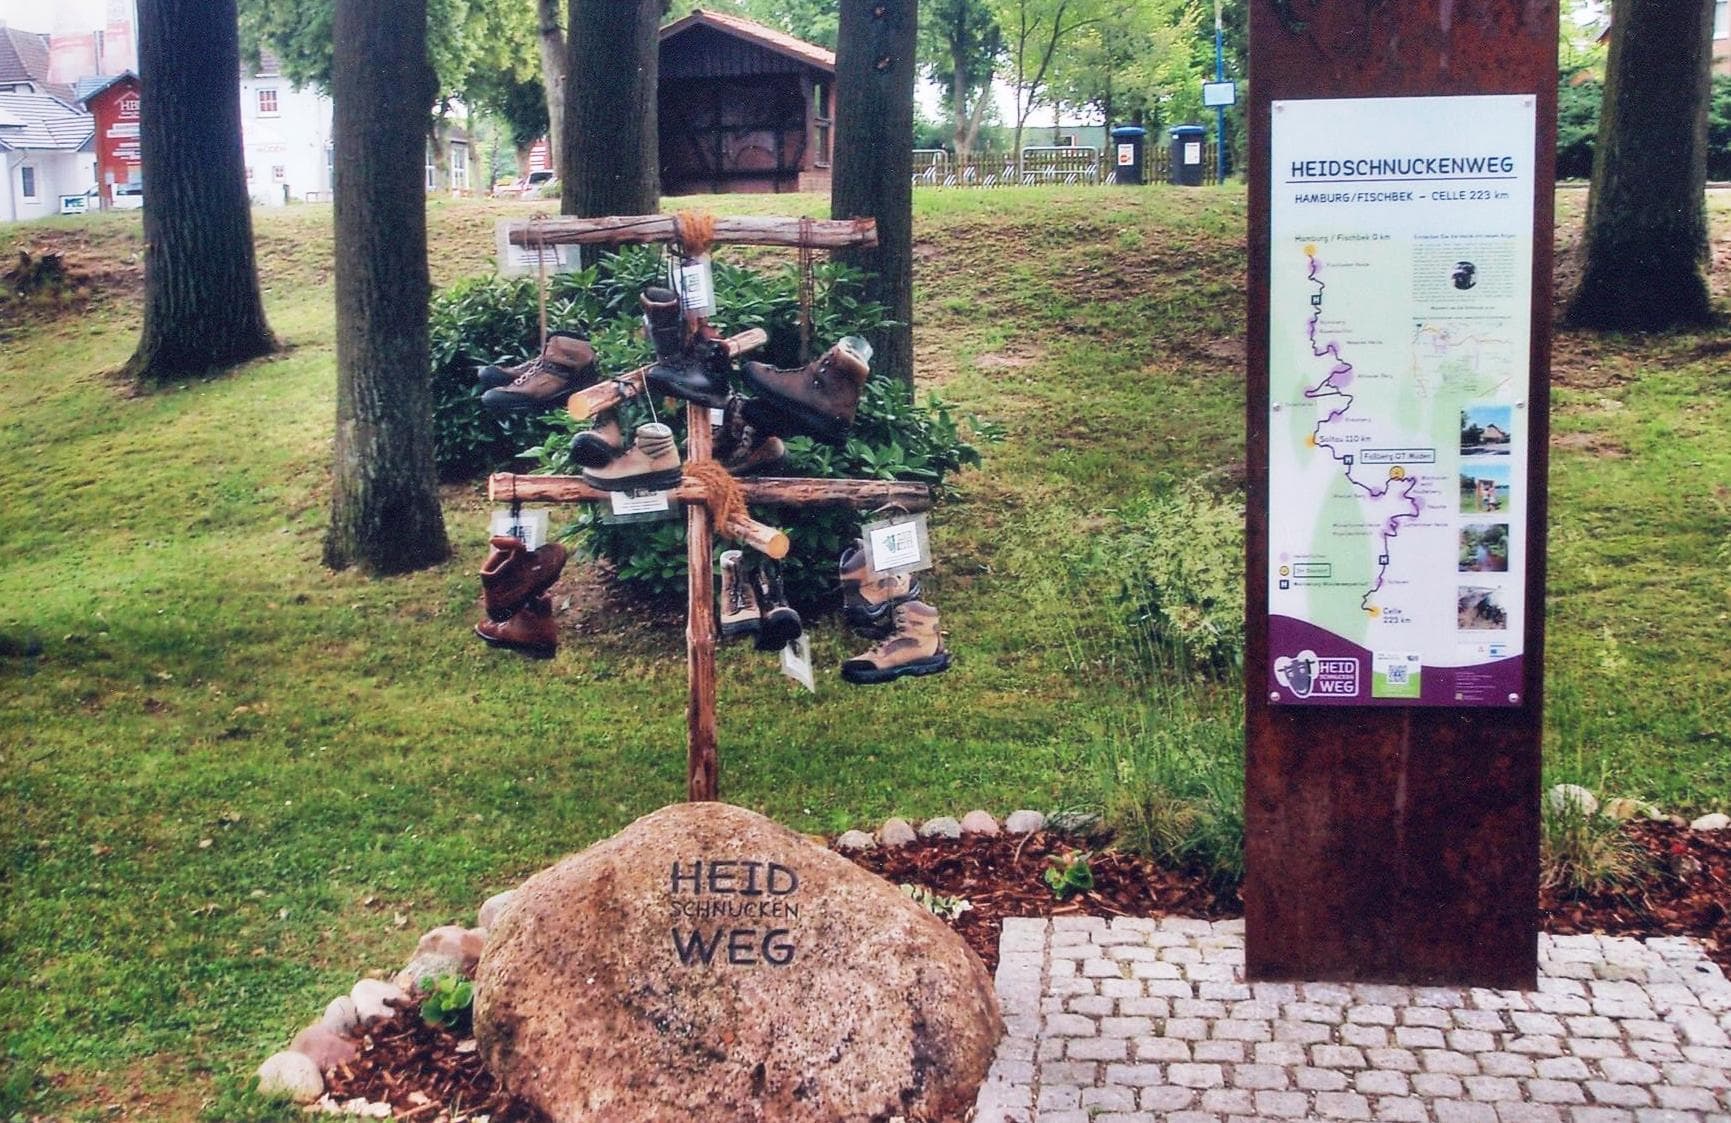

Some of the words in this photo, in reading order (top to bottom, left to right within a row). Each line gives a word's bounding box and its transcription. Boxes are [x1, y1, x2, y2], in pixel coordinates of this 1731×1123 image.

[1291, 157, 1513, 177] HEIDSCHNUCKENWEG
[1295, 192, 1413, 203] HAMBURG/FISCHBEK
[1432, 191, 1465, 200] CELLE
[1470, 191, 1490, 200] 223
[1494, 191, 1509, 199] km
[1383, 607, 1402, 615] Celle
[1320, 662, 1354, 673] HEID
[1320, 681, 1354, 692] WEG
[671, 860, 799, 896] HEID
[671, 901, 799, 918] SCHNUCKEN
[671, 927, 796, 966] WEG
